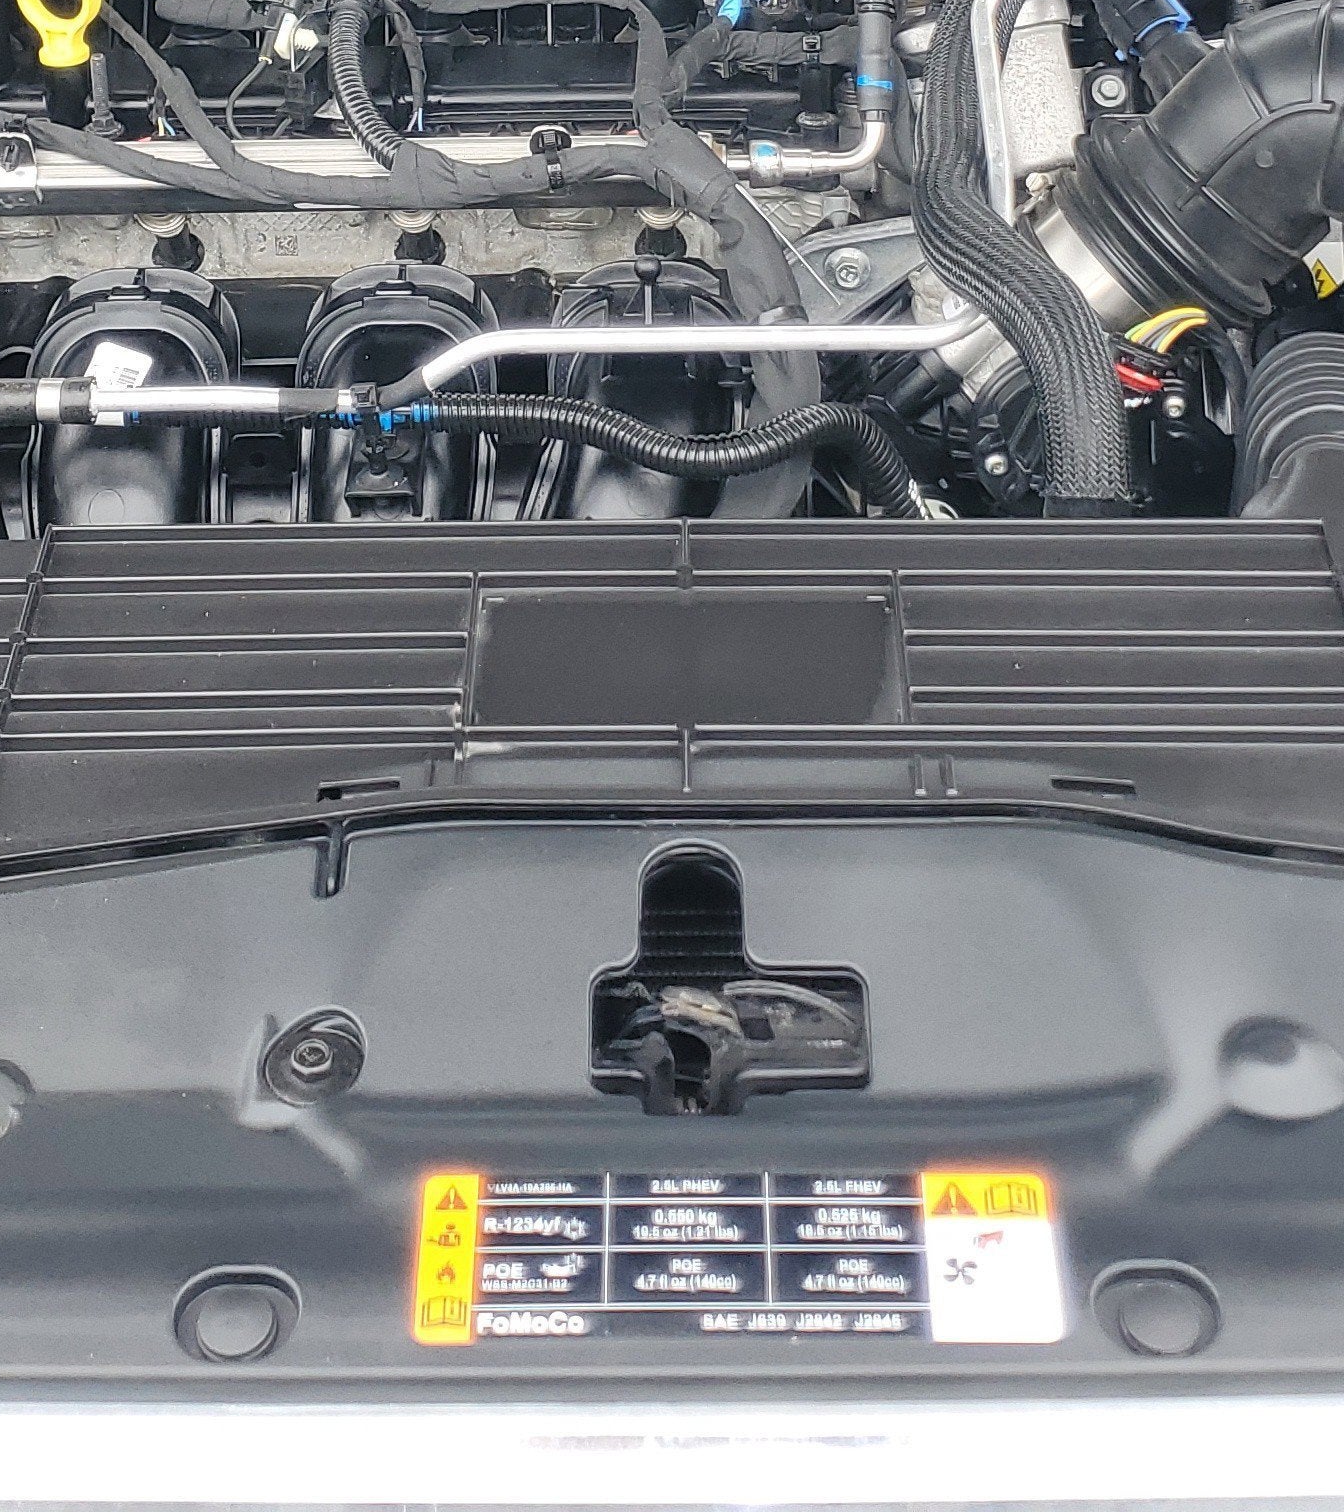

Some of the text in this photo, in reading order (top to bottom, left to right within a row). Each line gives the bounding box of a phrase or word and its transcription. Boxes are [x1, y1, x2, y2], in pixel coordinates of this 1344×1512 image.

[682, 1179, 720, 1192] PHEV
[845, 1180, 882, 1193] FHEV
[698, 1208, 718, 1228] kg
[861, 1207, 881, 1225] kg
[484, 1216, 561, 1236] R-1234yf
[662, 1228, 679, 1238] oz
[827, 1227, 844, 1238] oz
[483, 1262, 524, 1279] POE
[672, 1259, 702, 1273] POE
[838, 1259, 869, 1273] POE
[659, 1274, 668, 1289] fl
[671, 1277, 687, 1288] oz
[827, 1274, 836, 1289] fl
[839, 1278, 855, 1289] oz
[476, 1311, 586, 1335] FoMoCo
[703, 1312, 739, 1328] SAE
